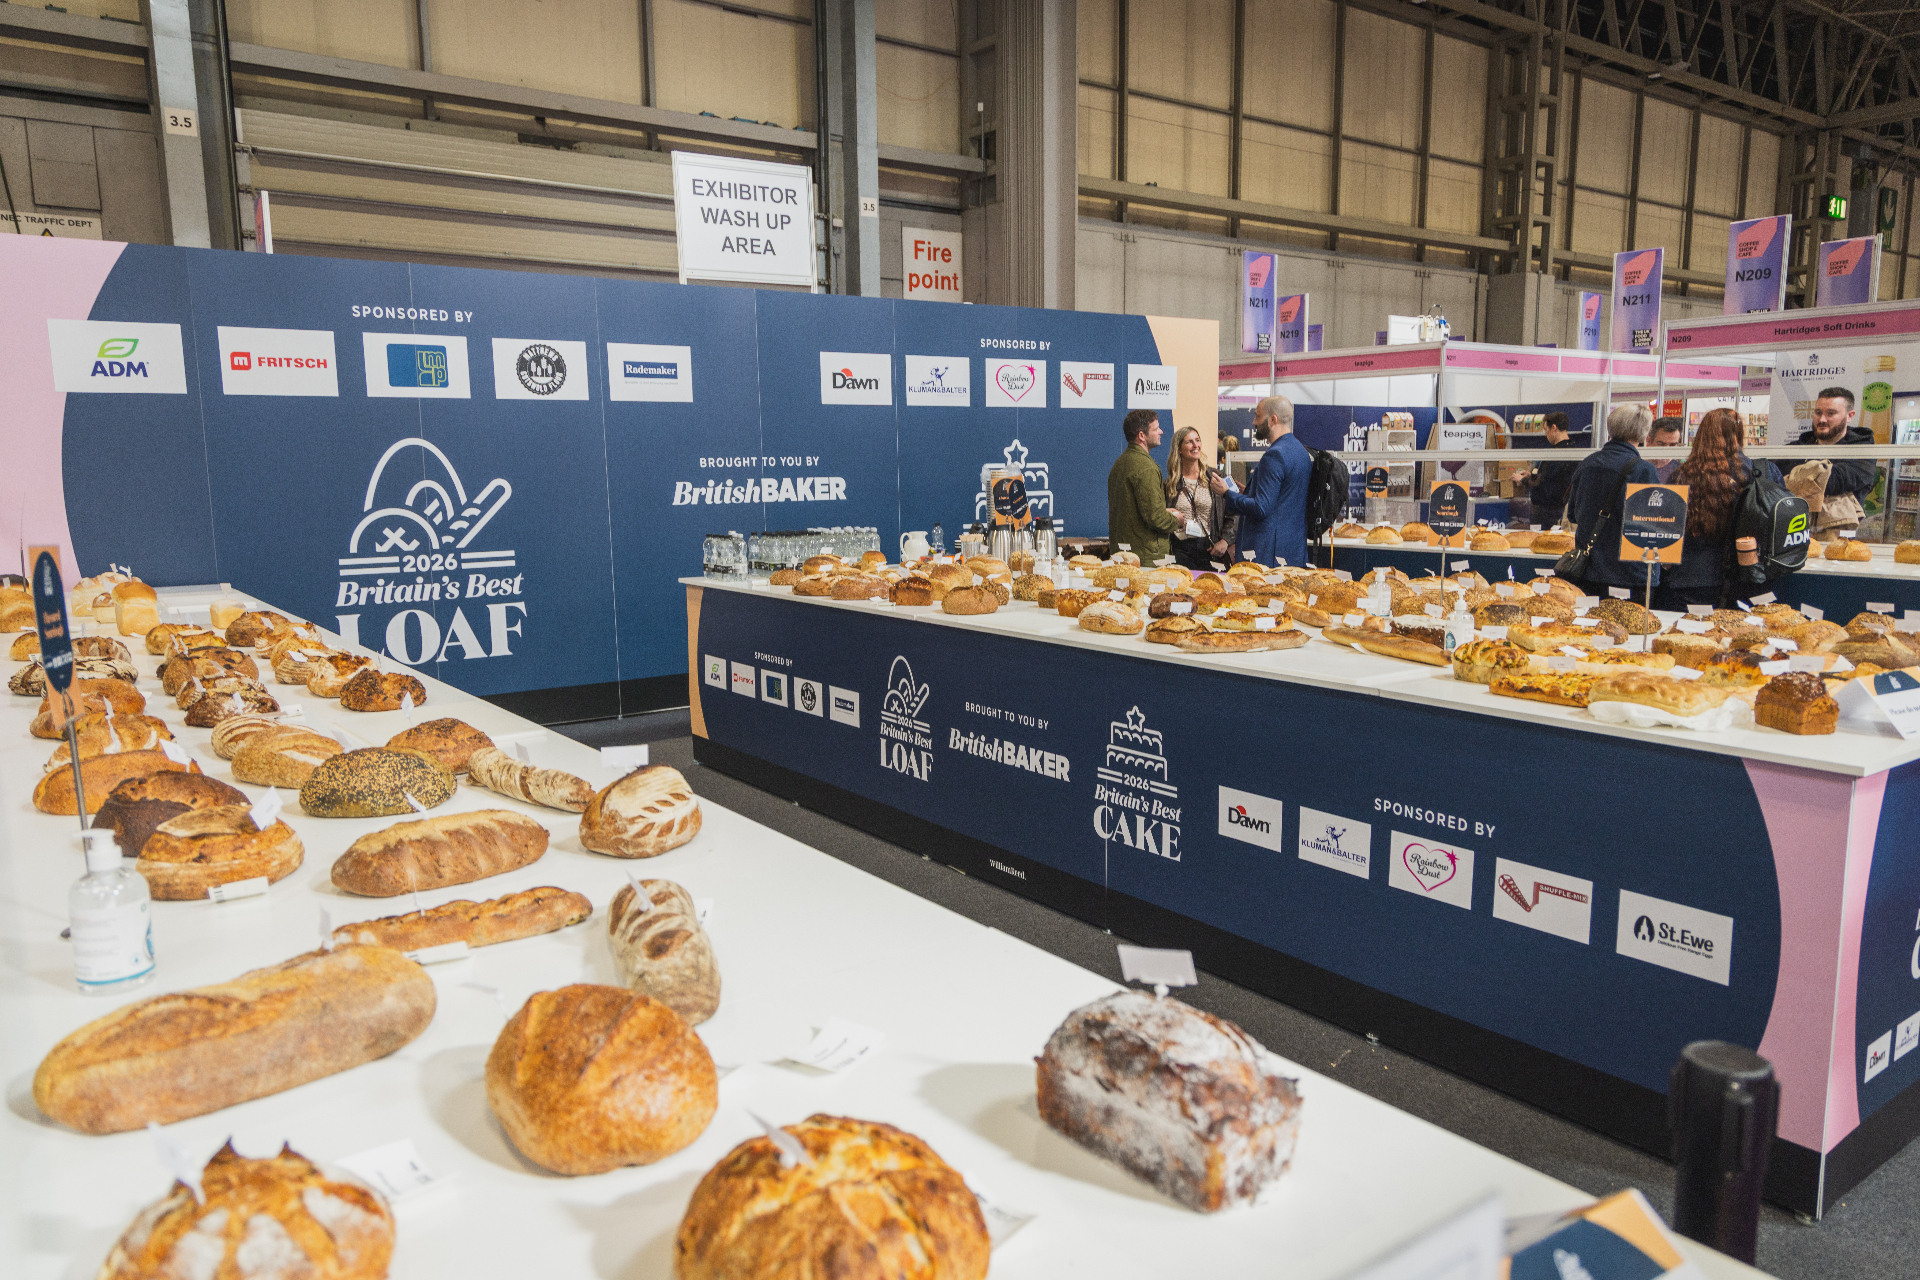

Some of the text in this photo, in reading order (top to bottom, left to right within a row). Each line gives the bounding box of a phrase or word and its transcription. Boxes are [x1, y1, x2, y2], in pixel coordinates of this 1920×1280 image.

[170, 115, 192, 128] 3.5
[691, 178, 798, 206] EXHIBITOR
[862, 202, 876, 213] 3.5
[0, 214, 93, 228] NEC TRAFFIC DEPT
[700, 206, 792, 230] WASH UP
[721, 236, 776, 256] AREA
[914, 240, 952, 264] Fire
[908, 272, 960, 292] point
[1736, 268, 1772, 282] N209
[1250, 297, 1268, 308] N211
[1622, 294, 1650, 306] N211
[352, 305, 473, 323] SPONSORED BY
[1280, 330, 1300, 339] N219
[1774, 326, 1821, 336] Hartridges
[1823, 323, 1842, 332] Soft
[1844, 321, 1876, 330] Drinks
[980, 338, 1051, 350] SPONSORED BY
[90, 360, 148, 378] ADM
[257, 356, 328, 369] FRITSCH
[625, 364, 676, 375] Rademaker
[832, 372, 879, 390] Dawn
[1781, 366, 1846, 378] HARTRIDGES
[1146, 379, 1170, 392] St.Ewe
[1349, 422, 1367, 438] for
[1444, 430, 1483, 439] teapigs.
[700, 456, 820, 468] BROUGHT TO YOU BY
[672, 476, 847, 506] BritishBAKER
[402, 553, 458, 573] 2026
[335, 573, 524, 607] Britain's Best
[335, 601, 527, 666] LOAF
[754, 651, 793, 667] SPONSORED BY
[897, 716, 912, 728] 2026
[966, 701, 1049, 730] BROUGHT TO YOU BY
[880, 722, 932, 750] Britain's Best
[880, 738, 934, 782] LOAF
[949, 728, 1070, 782] BritishBAKER
[1124, 774, 1150, 791] 2026
[1094, 784, 1182, 822] Britain's Best
[1228, 806, 1270, 834] Dawn
[1374, 798, 1496, 838] SPONSORED BY
[1093, 804, 1182, 862] CAKE
[1302, 838, 1367, 864] KLUMAN&BALTER
[1409, 853, 1449, 872] Rainbow
[1417, 865, 1441, 879] Dust
[1539, 884, 1588, 902] SHUFFLE-MIX
[1658, 922, 1714, 952] St.Ewe
